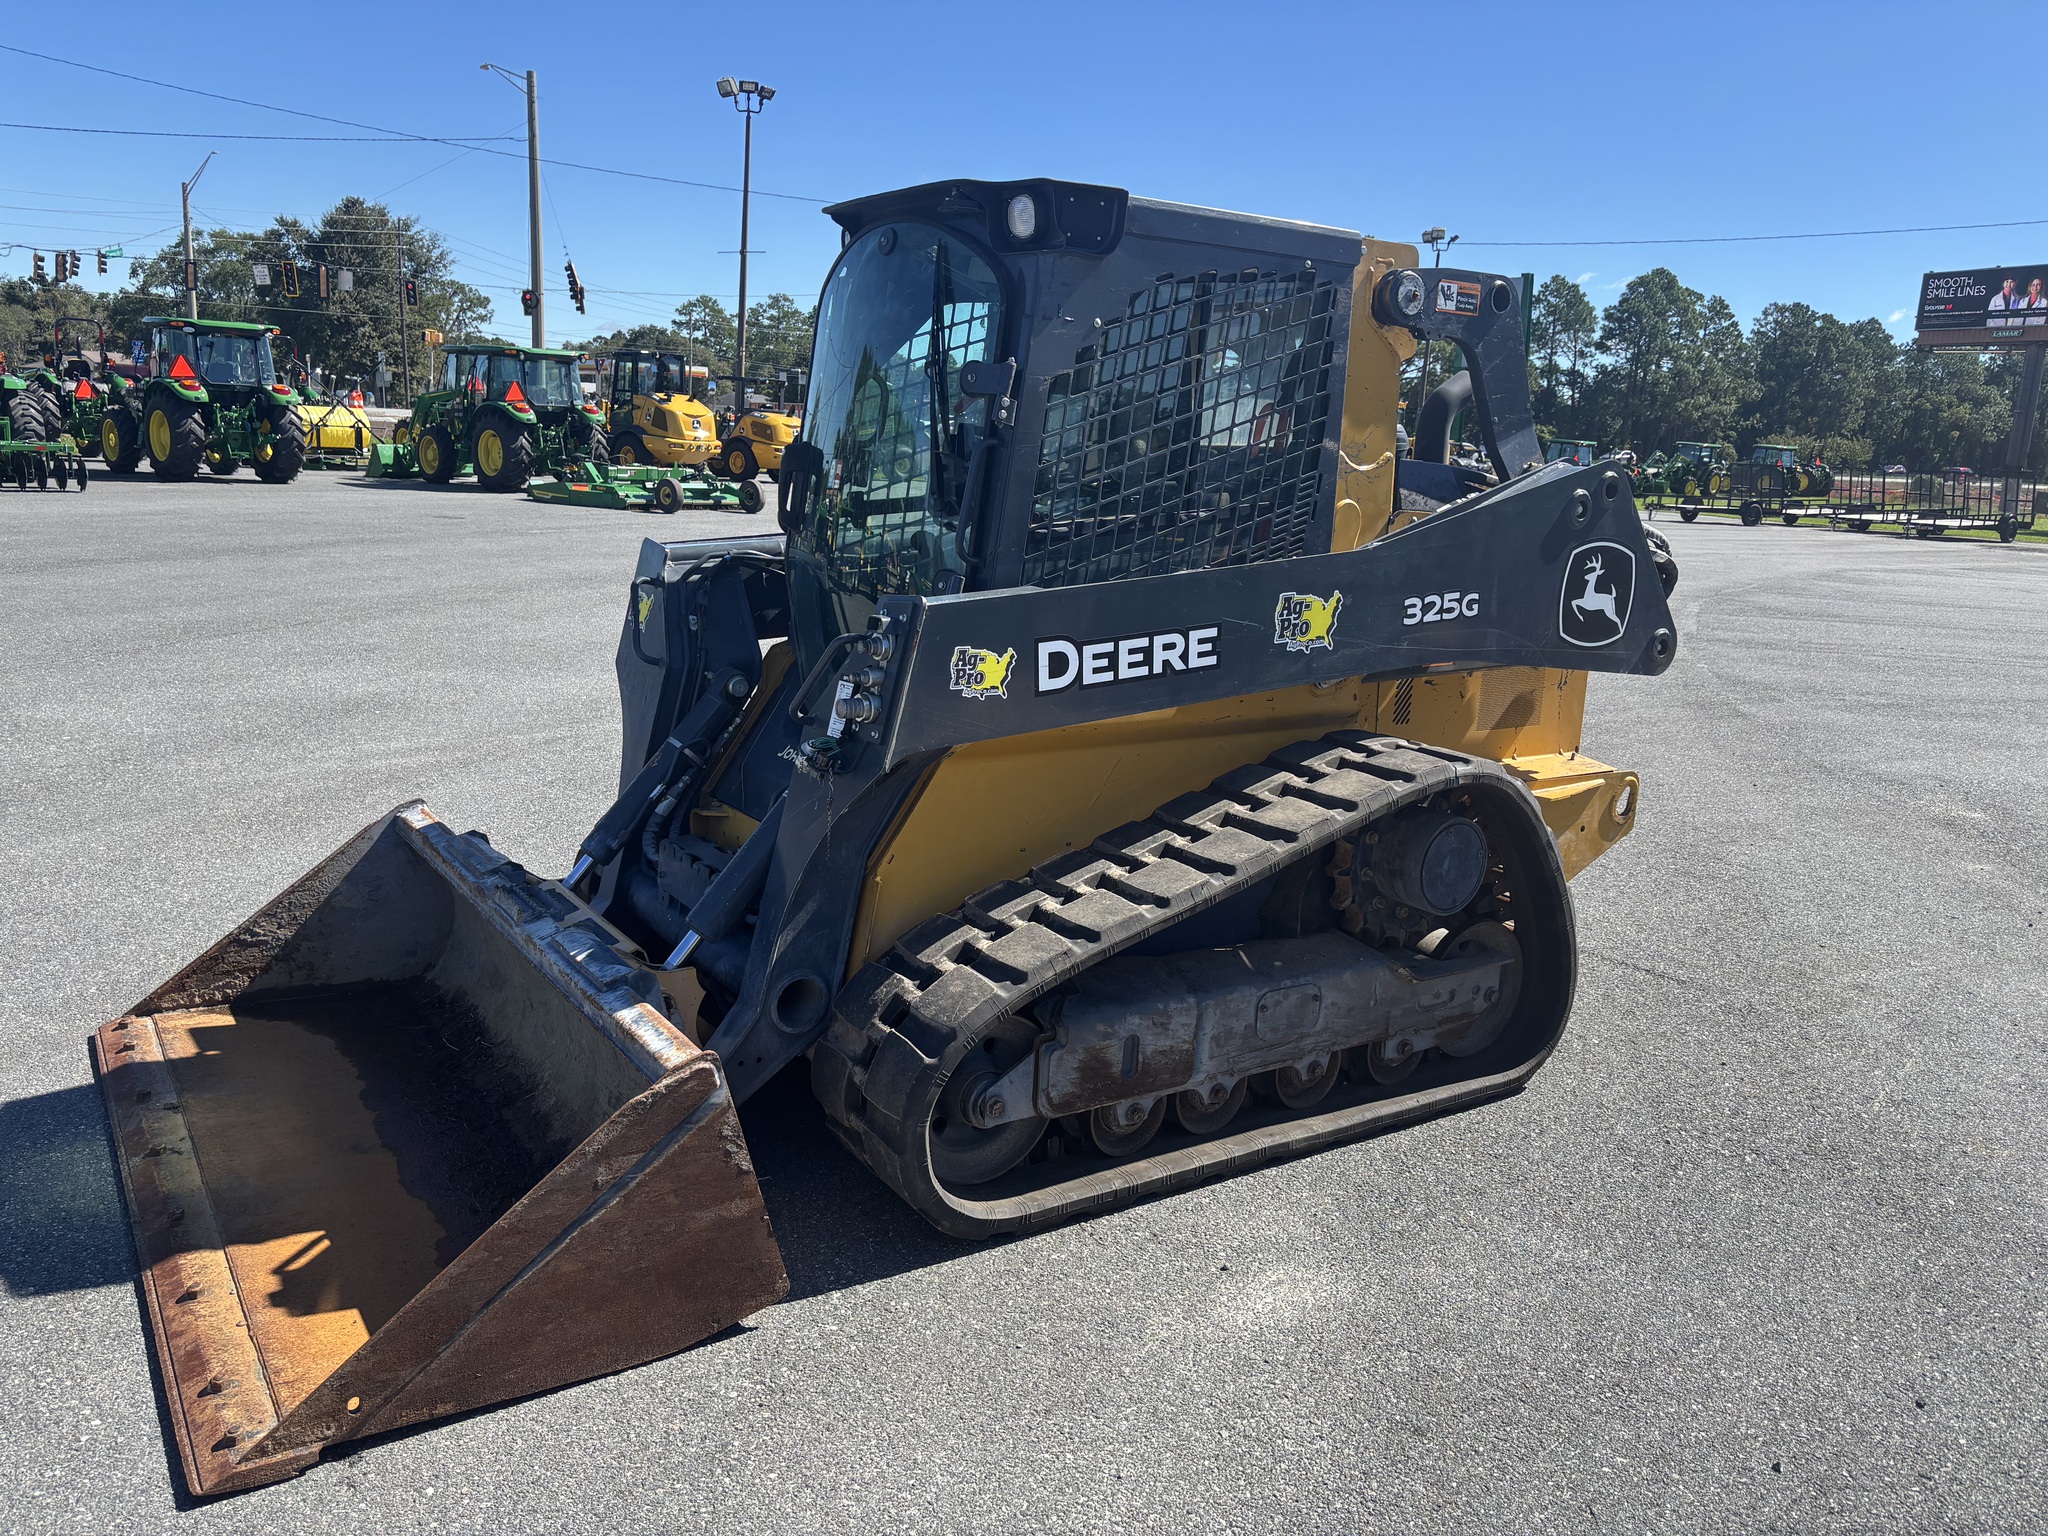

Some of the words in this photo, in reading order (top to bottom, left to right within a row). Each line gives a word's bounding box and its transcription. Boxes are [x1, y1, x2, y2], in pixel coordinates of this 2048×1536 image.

[1926, 287, 1956, 299] SMILE
[1957, 285, 1987, 297] LINES
[1928, 276, 1974, 289] SMOOTH
[1403, 592, 1480, 626] 325G
[1277, 618, 1311, 640] Pro
[1037, 626, 1219, 693] DEERE
[953, 668, 986, 687] Pro
[777, 745, 798, 762] JOH
